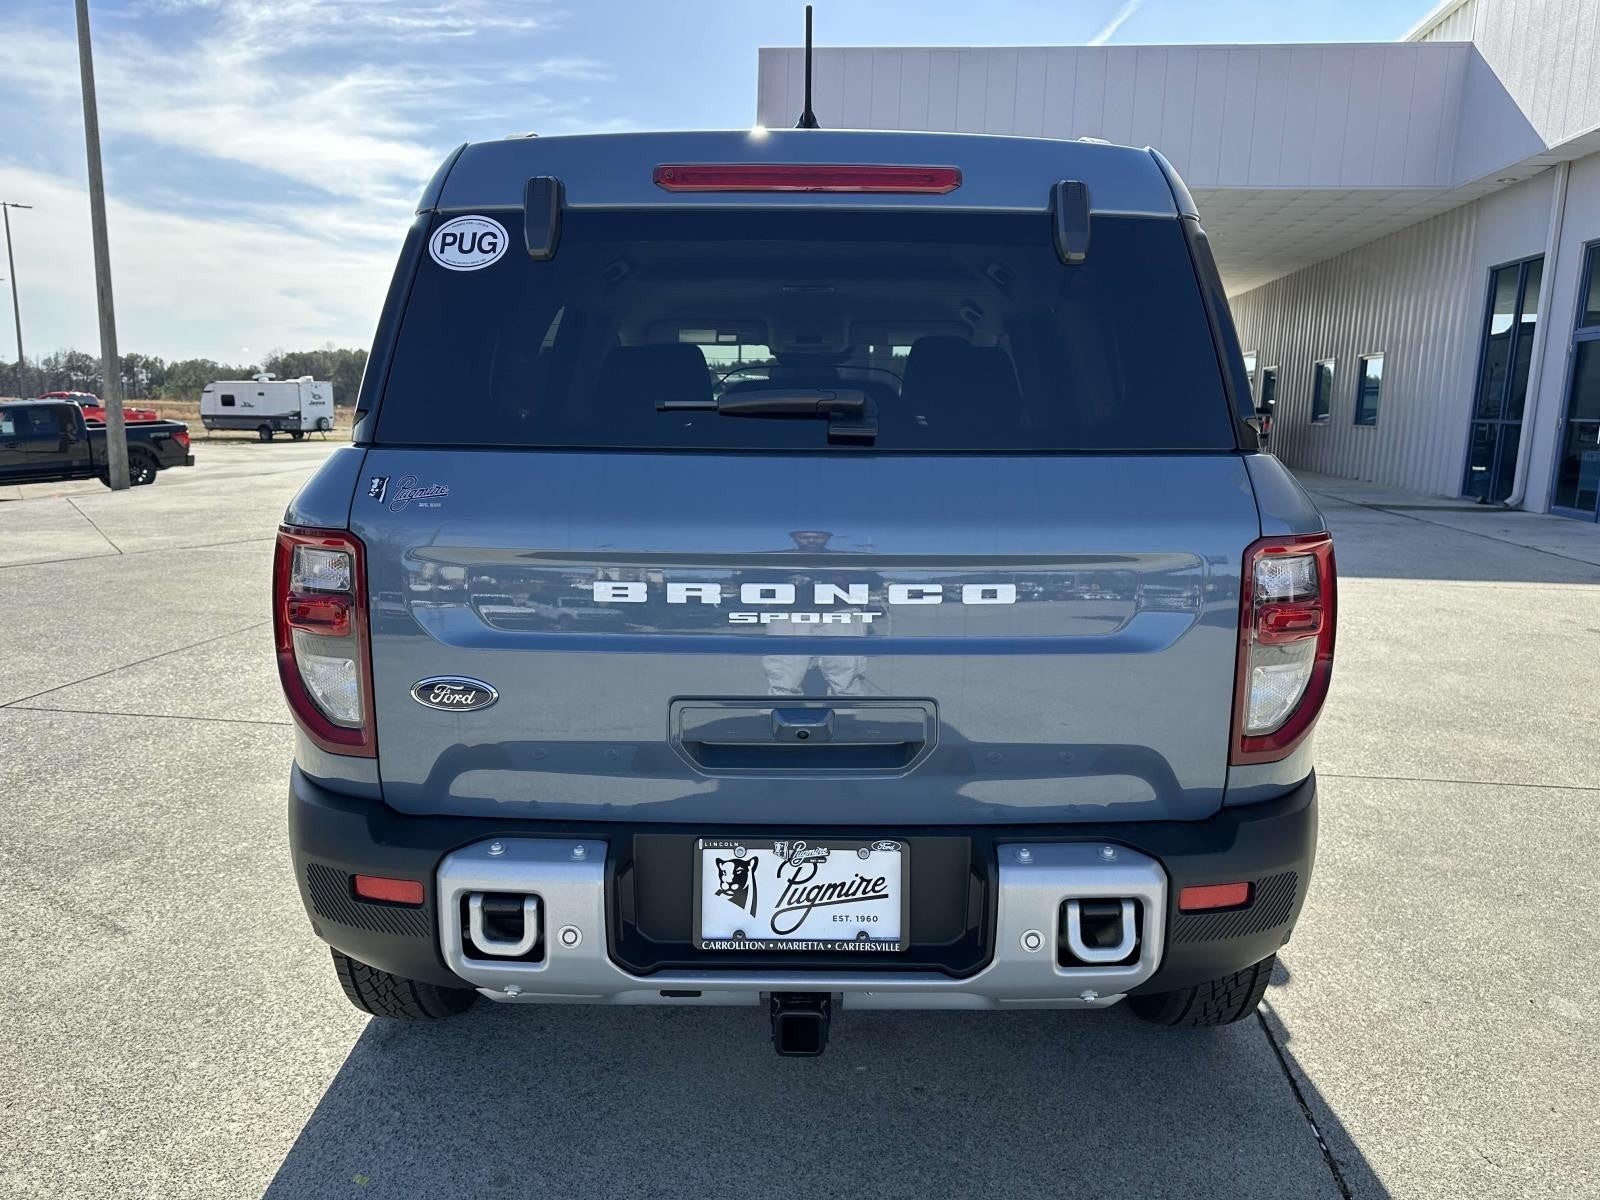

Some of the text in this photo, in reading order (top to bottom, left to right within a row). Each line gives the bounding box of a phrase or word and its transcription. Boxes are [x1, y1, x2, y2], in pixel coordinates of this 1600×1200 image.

[439, 231, 498, 254] PUG
[593, 581, 1017, 604] BRONCO
[728, 612, 882, 624] SPORT
[429, 683, 476, 704] Ford
[791, 840, 828, 866] Pugmire
[770, 860, 889, 936] Pugmire
[832, 914, 879, 923] EST. 1960
[701, 941, 900, 952] CARROLLTON MARIETTA CARTERSVILLE
